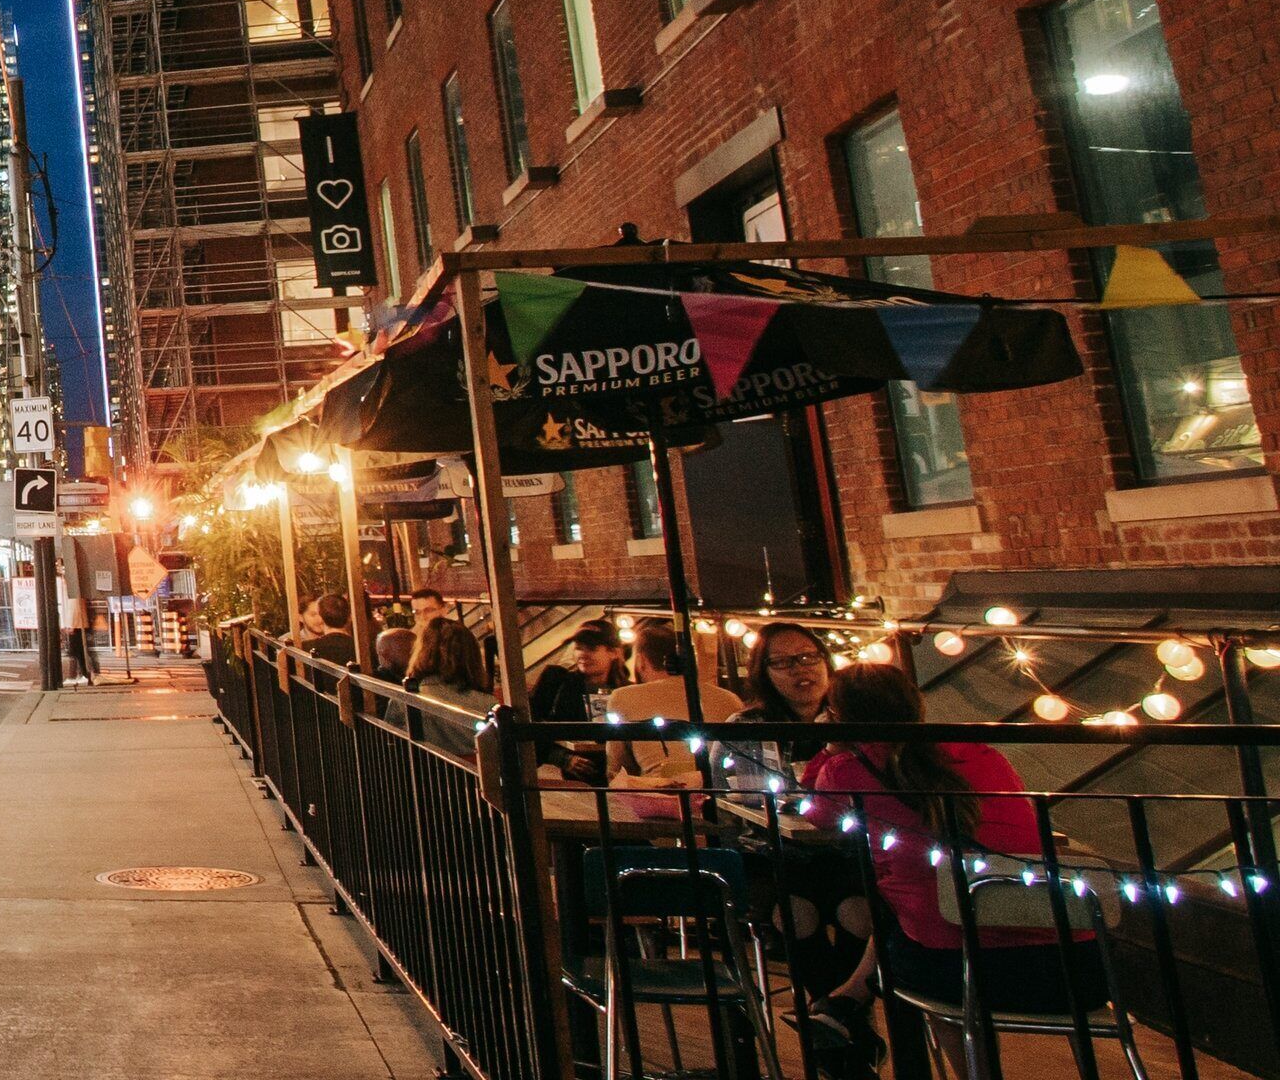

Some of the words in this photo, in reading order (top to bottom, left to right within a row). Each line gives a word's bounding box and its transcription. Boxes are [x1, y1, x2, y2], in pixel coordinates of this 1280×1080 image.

[536, 338, 701, 385] SAPPORO
[542, 377, 641, 397] PREMIUM
[649, 367, 701, 386] BEER
[14, 404, 47, 413] MAXIMUM
[17, 420, 49, 442] 40
[38, 521, 56, 529] LANE
